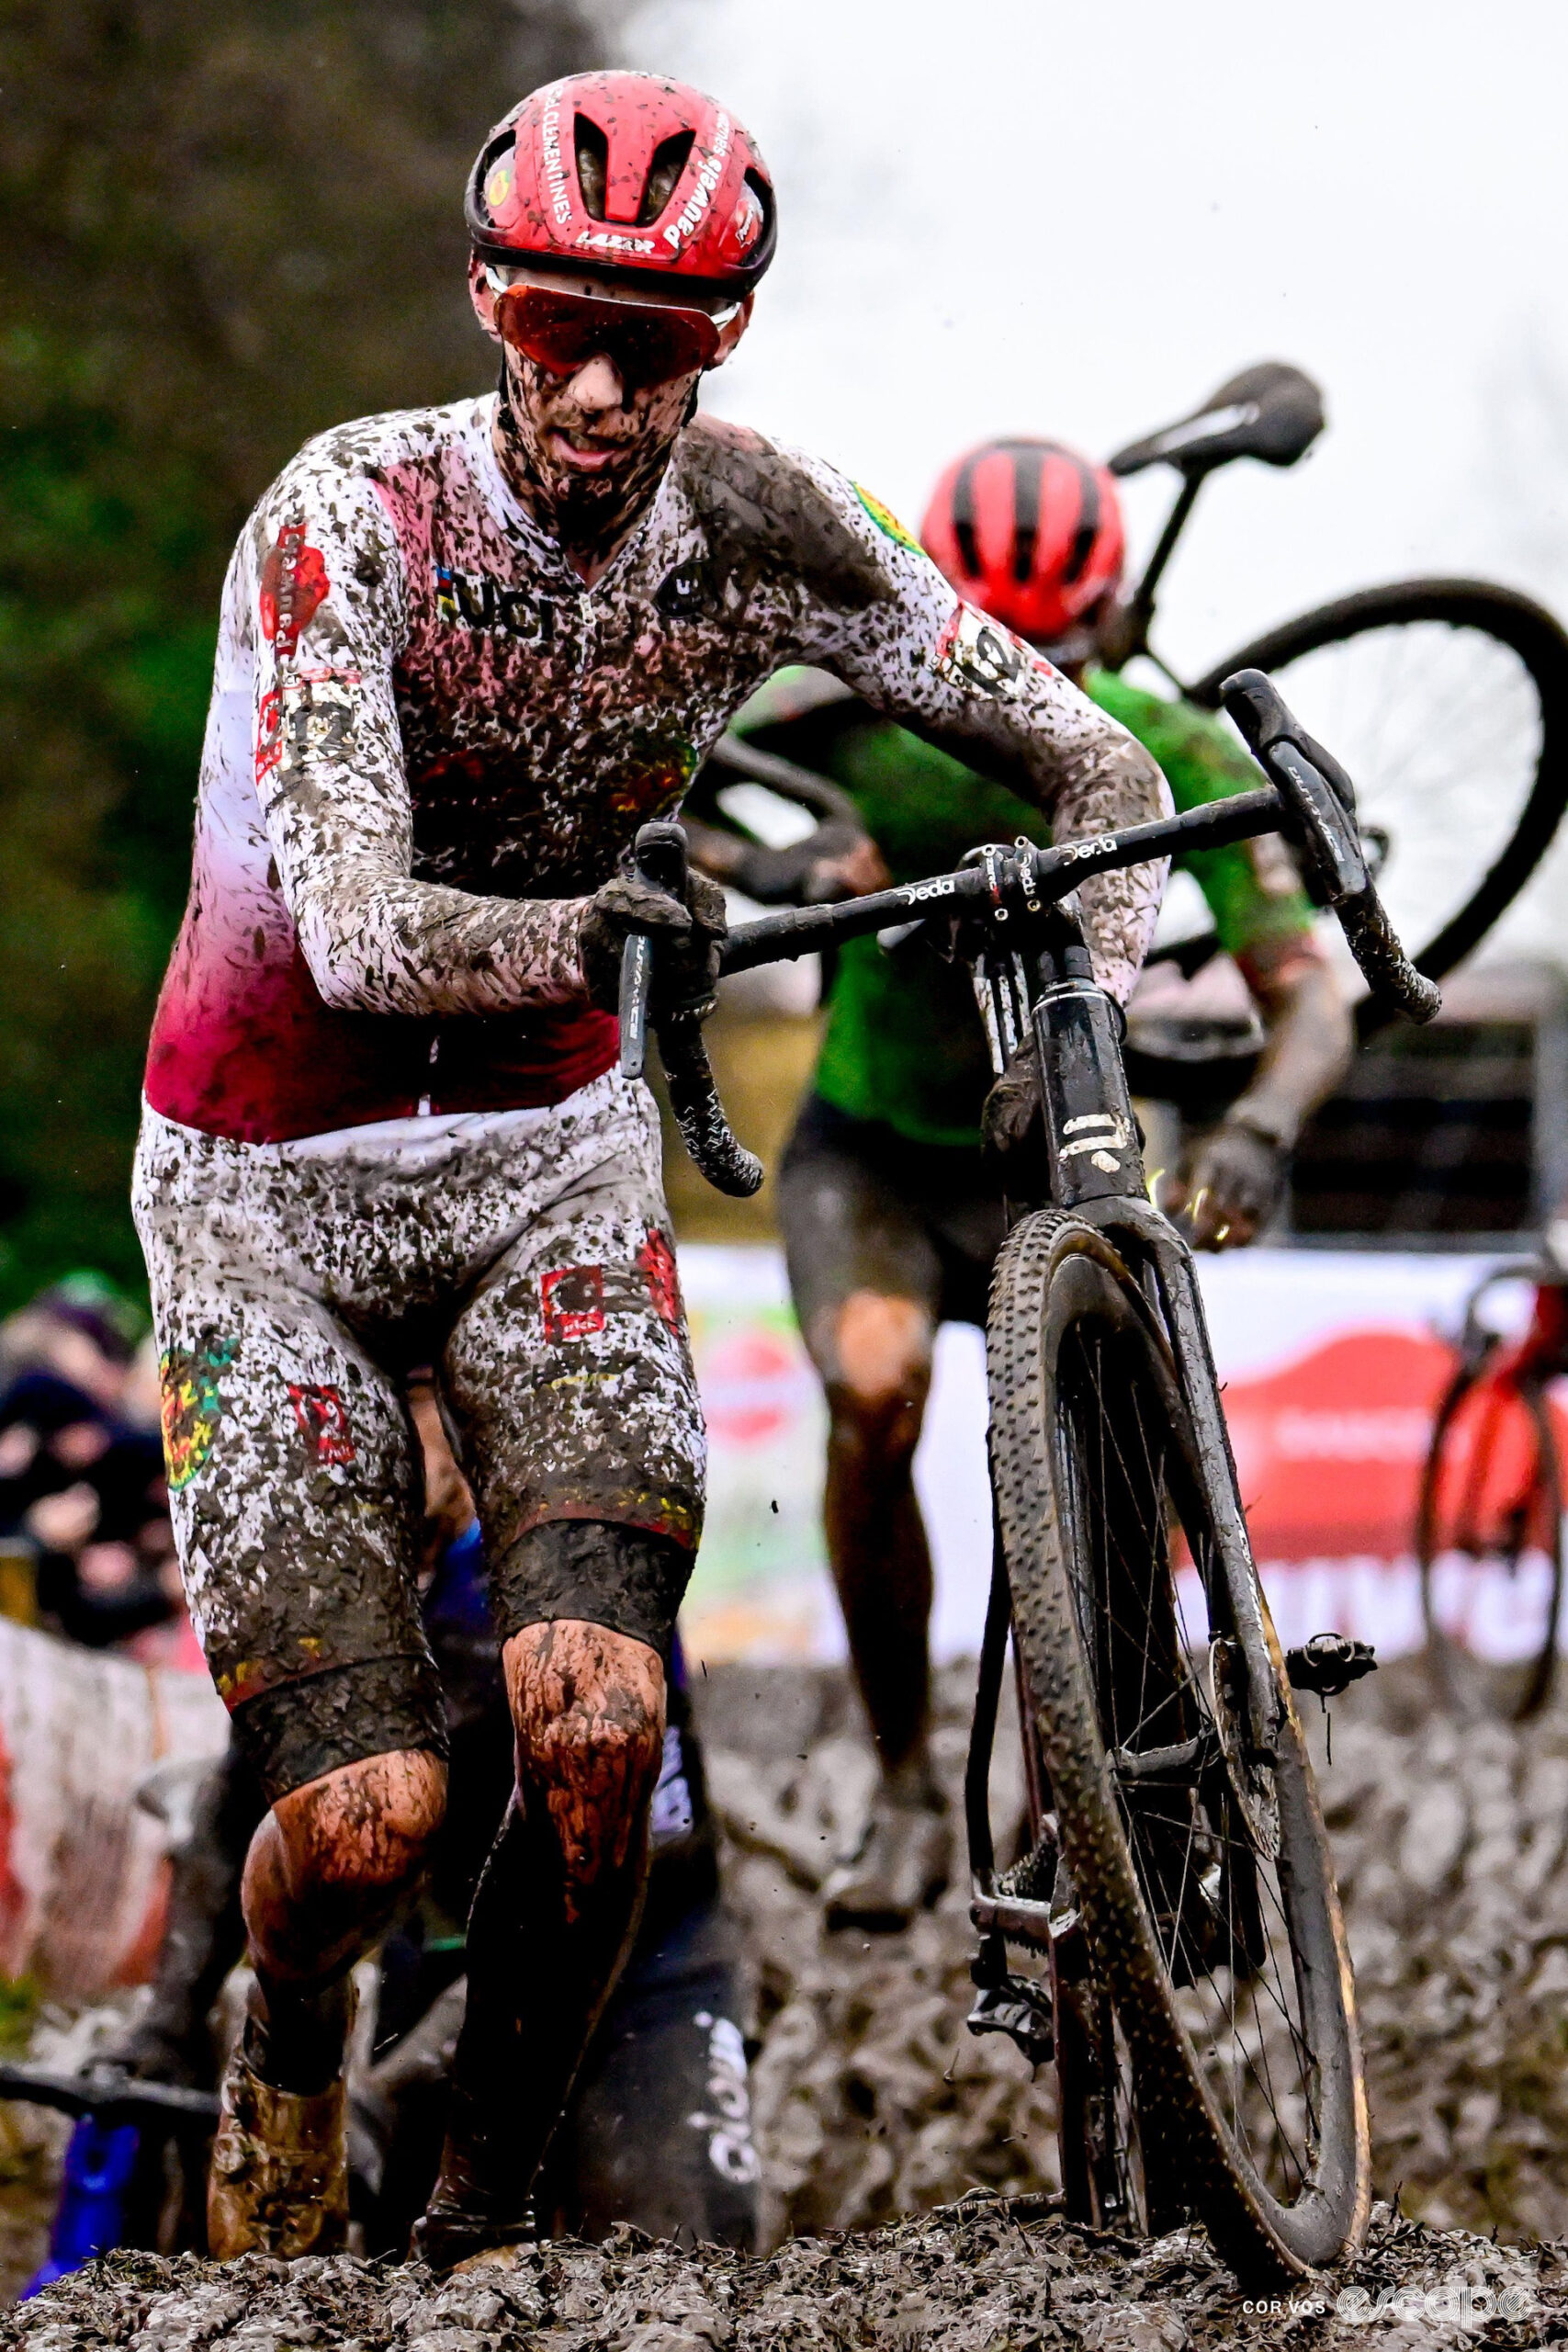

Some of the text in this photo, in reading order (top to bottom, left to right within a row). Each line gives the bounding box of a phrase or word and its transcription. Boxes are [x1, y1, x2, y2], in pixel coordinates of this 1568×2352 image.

[542, 110, 573, 224] CLEMENTINES
[663, 157, 723, 249] Pauwels
[896, 879, 955, 905] Deda
